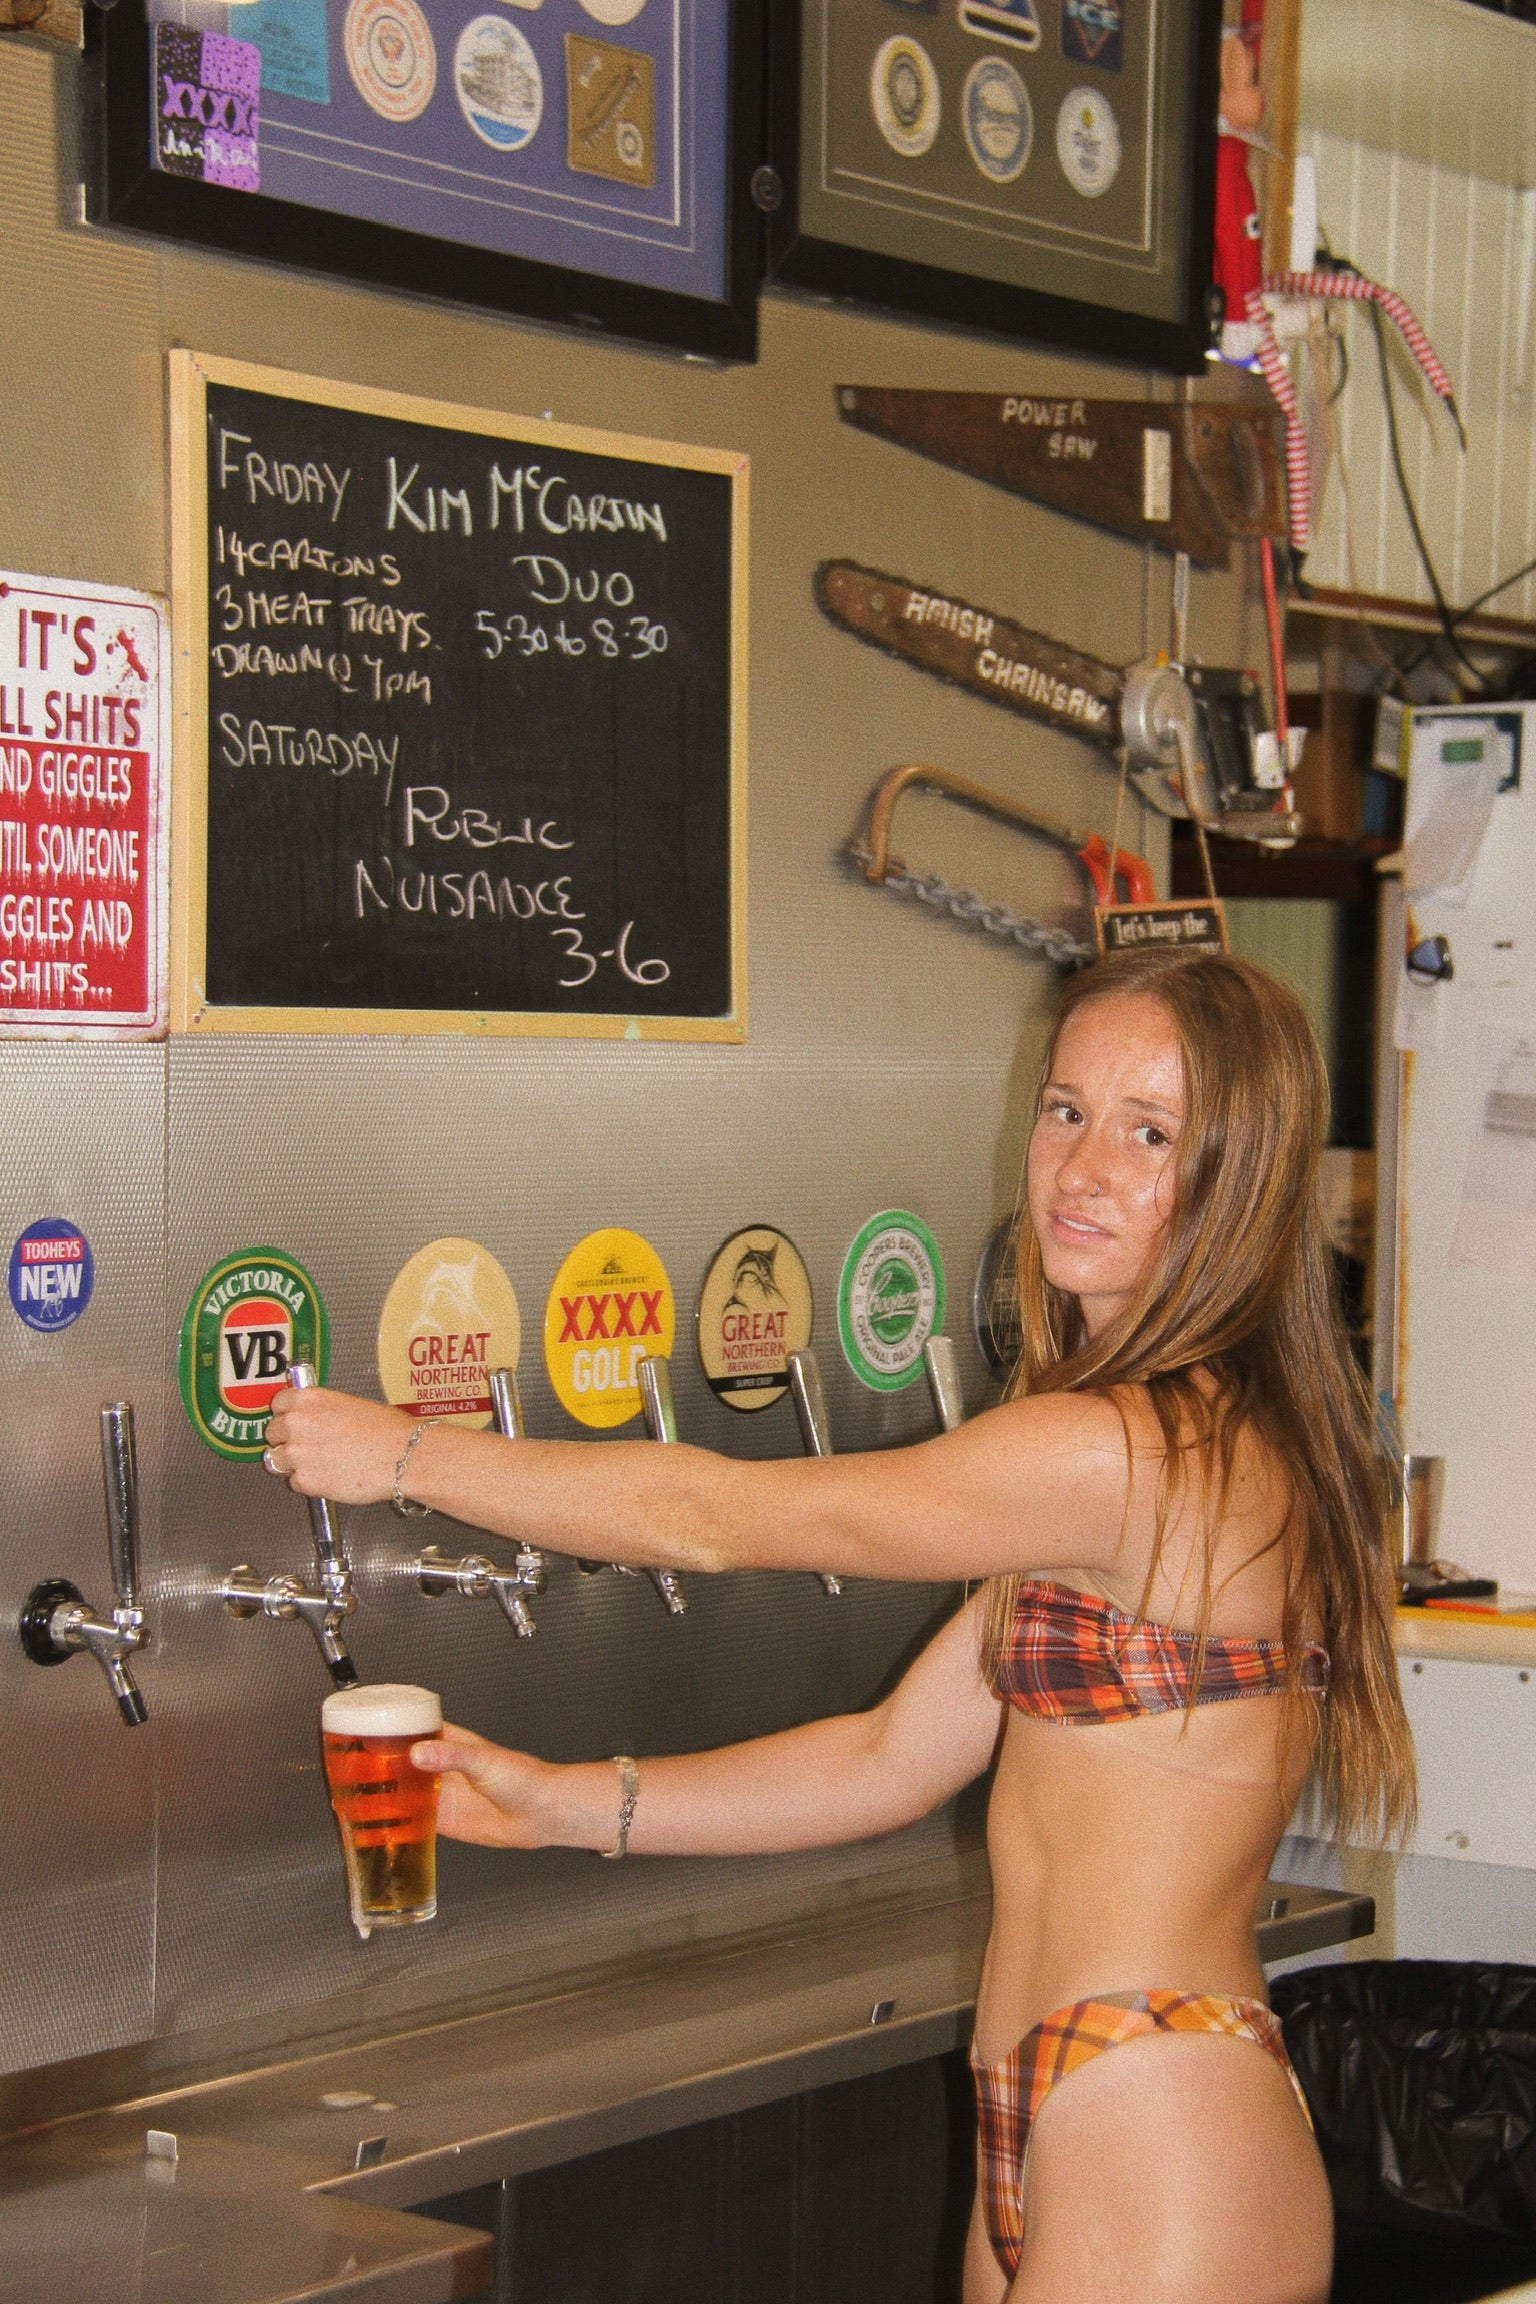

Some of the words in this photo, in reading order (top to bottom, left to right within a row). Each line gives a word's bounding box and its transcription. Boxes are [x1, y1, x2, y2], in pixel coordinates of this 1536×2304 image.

[1000, 397, 1087, 426] POWER
[1048, 431, 1098, 460] SAW
[219, 429, 350, 522] FRIDAY
[386, 457, 472, 536] KIM
[512, 554, 635, 606] DUO
[18, 608, 96, 676] IT'S
[904, 591, 994, 645] AMISH
[976, 649, 1108, 723] CHAINSAW
[45, 690, 142, 748] SHITS
[39, 749, 132, 802] GIGGLES
[218, 713, 399, 807] SATURDAY
[404, 785, 574, 849] PUBLIC
[0, 821, 31, 872] TIL
[37, 824, 139, 879] SOMEONE
[356, 857, 586, 920] NUISANCE
[80, 898, 133, 945] AND
[552, 920, 670, 987] 3-6
[24, 1241, 81, 1260] TOOHEYS
[21, 1263, 83, 1301] NEW
[204, 1270, 306, 1316] VICTORIA
[557, 1289, 664, 1344] XXXX
[721, 1311, 789, 1342] GREAT
[224, 1330, 287, 1380] VB
[408, 1332, 491, 1366] GREAT
[721, 1341, 787, 1361] NORTHERN
[410, 1364, 490, 1387] NORTHERN
[417, 1385, 461, 1400] BREWING
[211, 1407, 273, 1441] BITT
[420, 1402, 457, 1414] ORIGINAL
[458, 1400, 477, 1412] 4.2%
